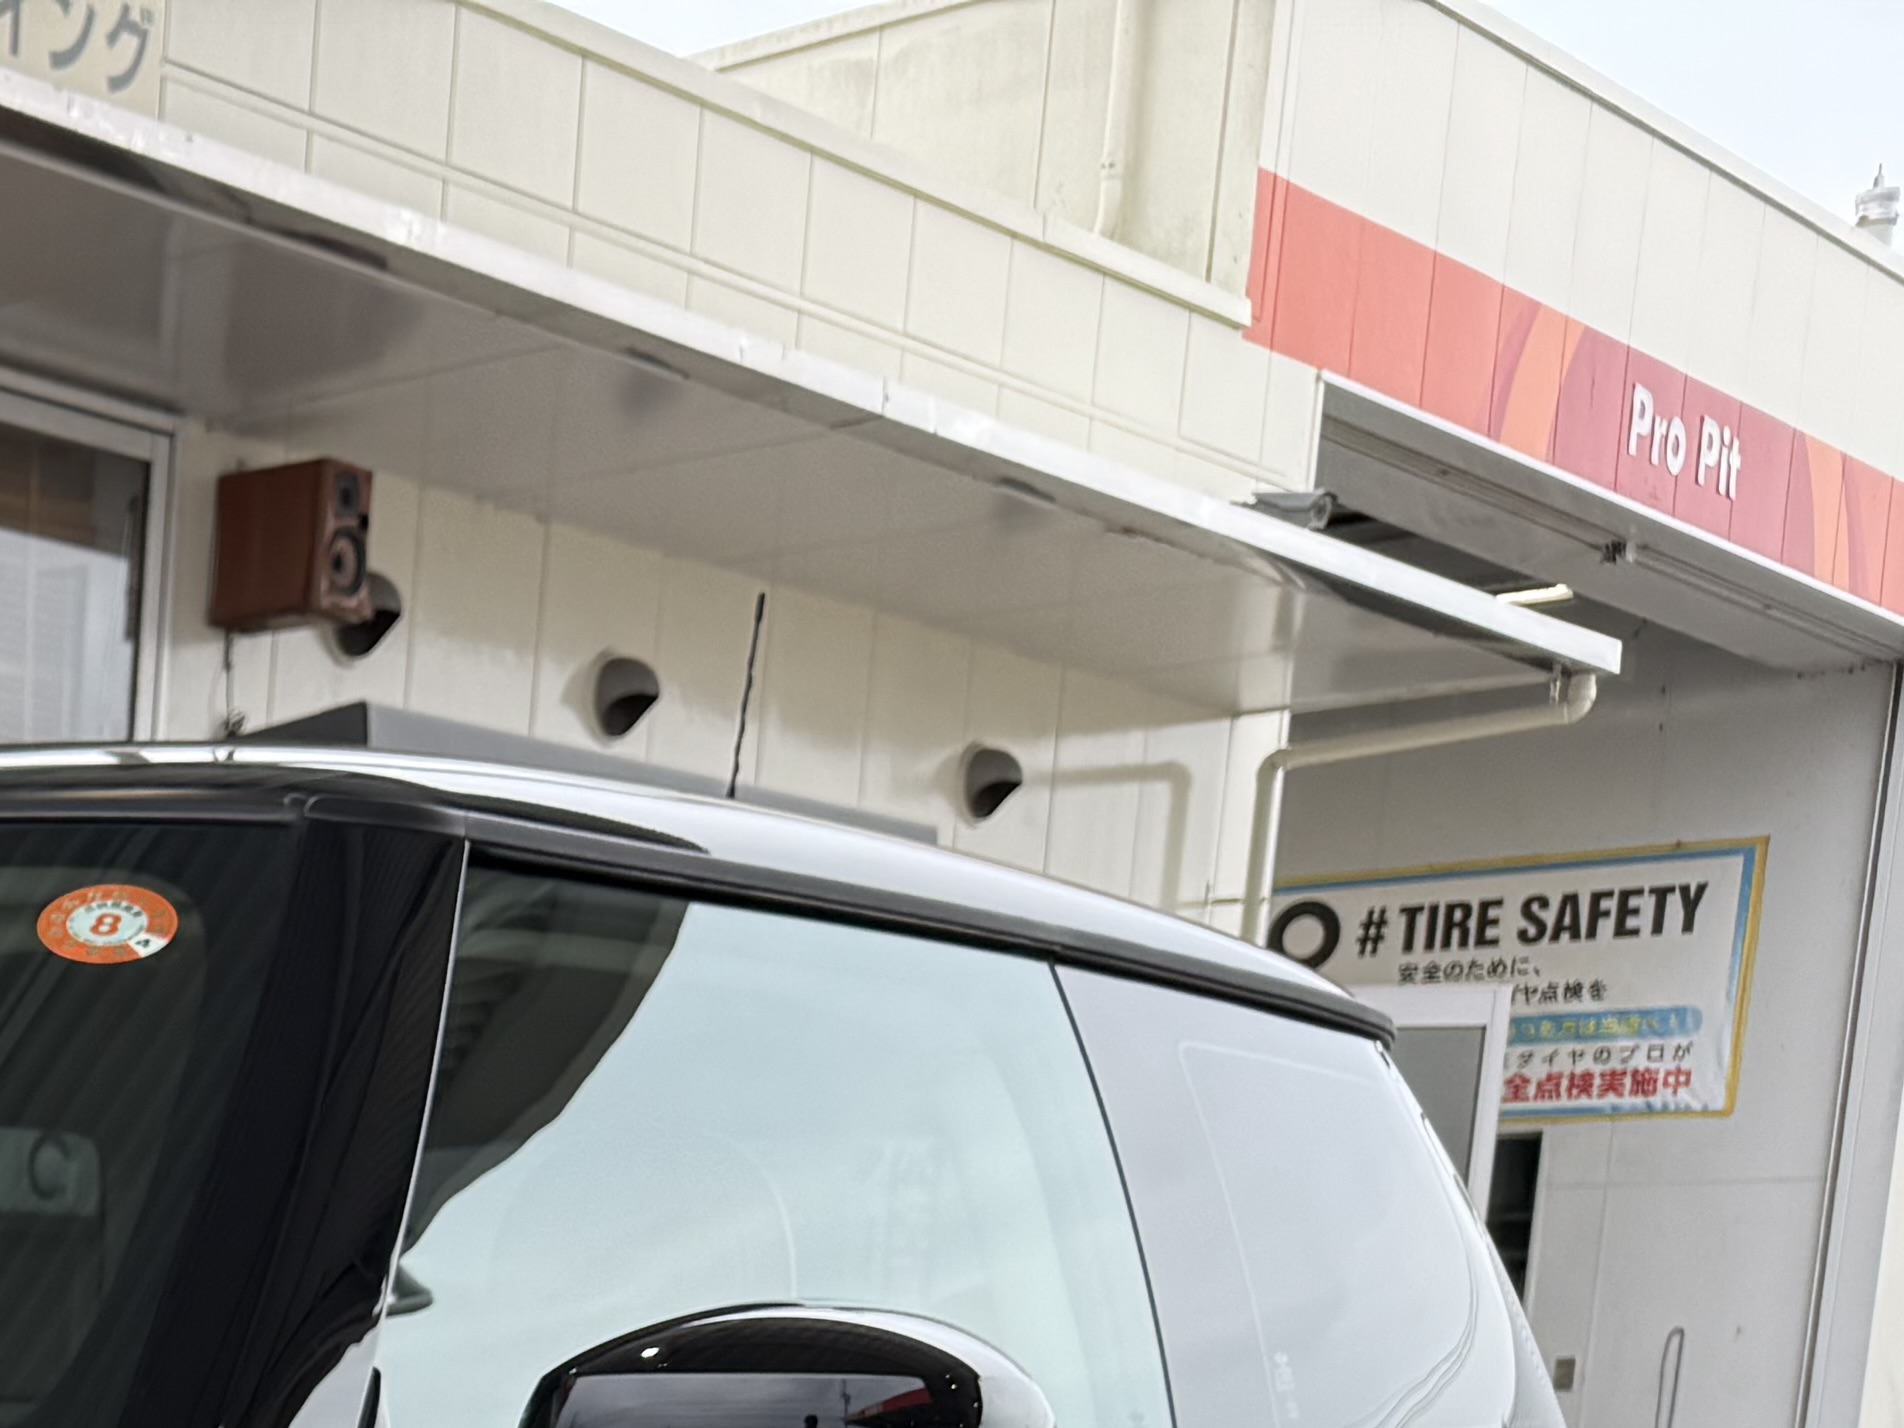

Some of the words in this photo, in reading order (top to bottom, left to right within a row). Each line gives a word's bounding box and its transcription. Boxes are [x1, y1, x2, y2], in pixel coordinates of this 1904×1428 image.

[1628, 383, 1686, 476] Pro
[1697, 414, 1741, 501] Pit
[90, 912, 122, 937] 8
[1516, 880, 1709, 948] SAFETY
[1508, 1040, 1693, 1070] タイヤのプロが
